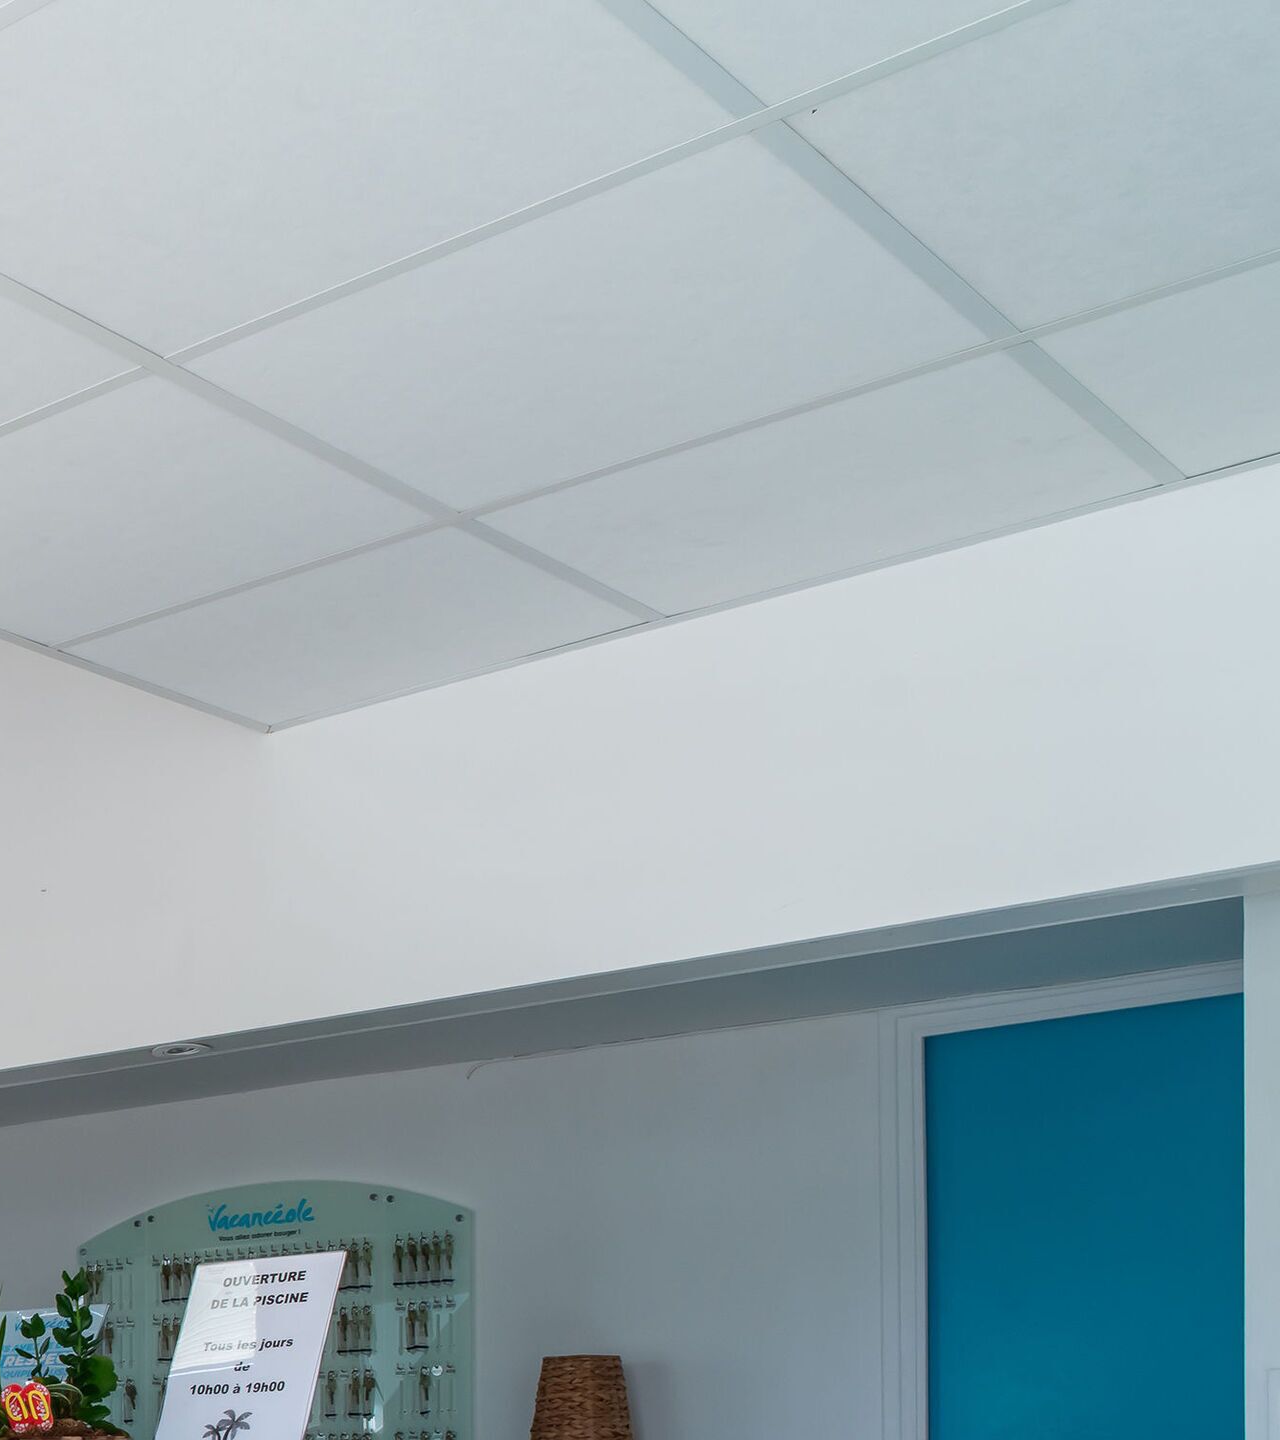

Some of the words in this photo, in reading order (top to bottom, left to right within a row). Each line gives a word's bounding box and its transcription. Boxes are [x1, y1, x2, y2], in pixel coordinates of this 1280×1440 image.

[208, 1198, 315, 1232] Vacancéole
[223, 1270, 307, 1288] OUVERTURE
[211, 1298, 228, 1310] DE
[232, 1296, 249, 1308] LA
[253, 1291, 309, 1307] PISCINE
[204, 1341, 233, 1352] Tous
[237, 1339, 257, 1350] les
[259, 1338, 294, 1351] jours
[234, 1361, 251, 1372] de
[190, 1383, 229, 1395] 10h00
[233, 1384, 241, 1394] à
[245, 1380, 286, 1393] 19h00
